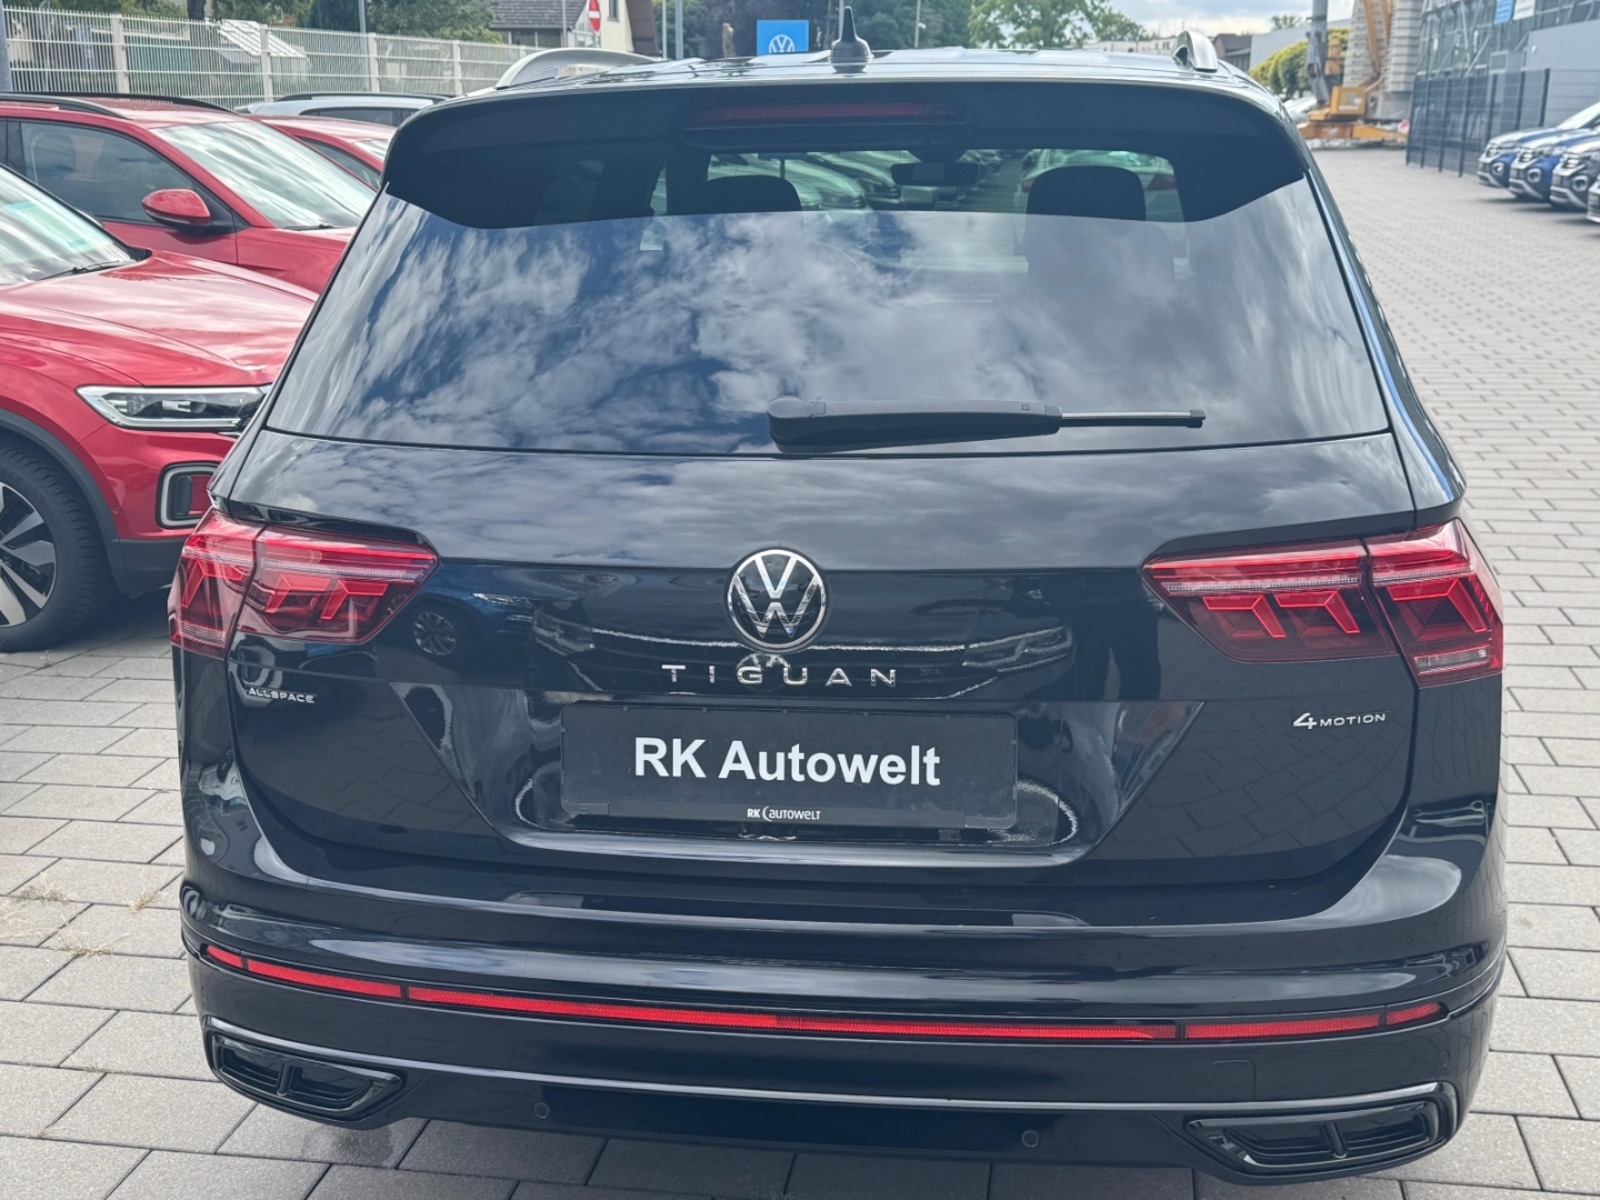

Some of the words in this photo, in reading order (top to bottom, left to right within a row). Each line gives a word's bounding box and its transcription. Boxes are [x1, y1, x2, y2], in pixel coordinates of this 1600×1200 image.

[733, 553, 822, 638] VW
[661, 664, 896, 687] TIGUAN
[248, 687, 315, 704] ALLSPACE
[1293, 712, 1386, 730] 4MOTION
[634, 737, 707, 779] RK
[718, 740, 941, 787] Autowelt
[747, 808, 761, 819] RK
